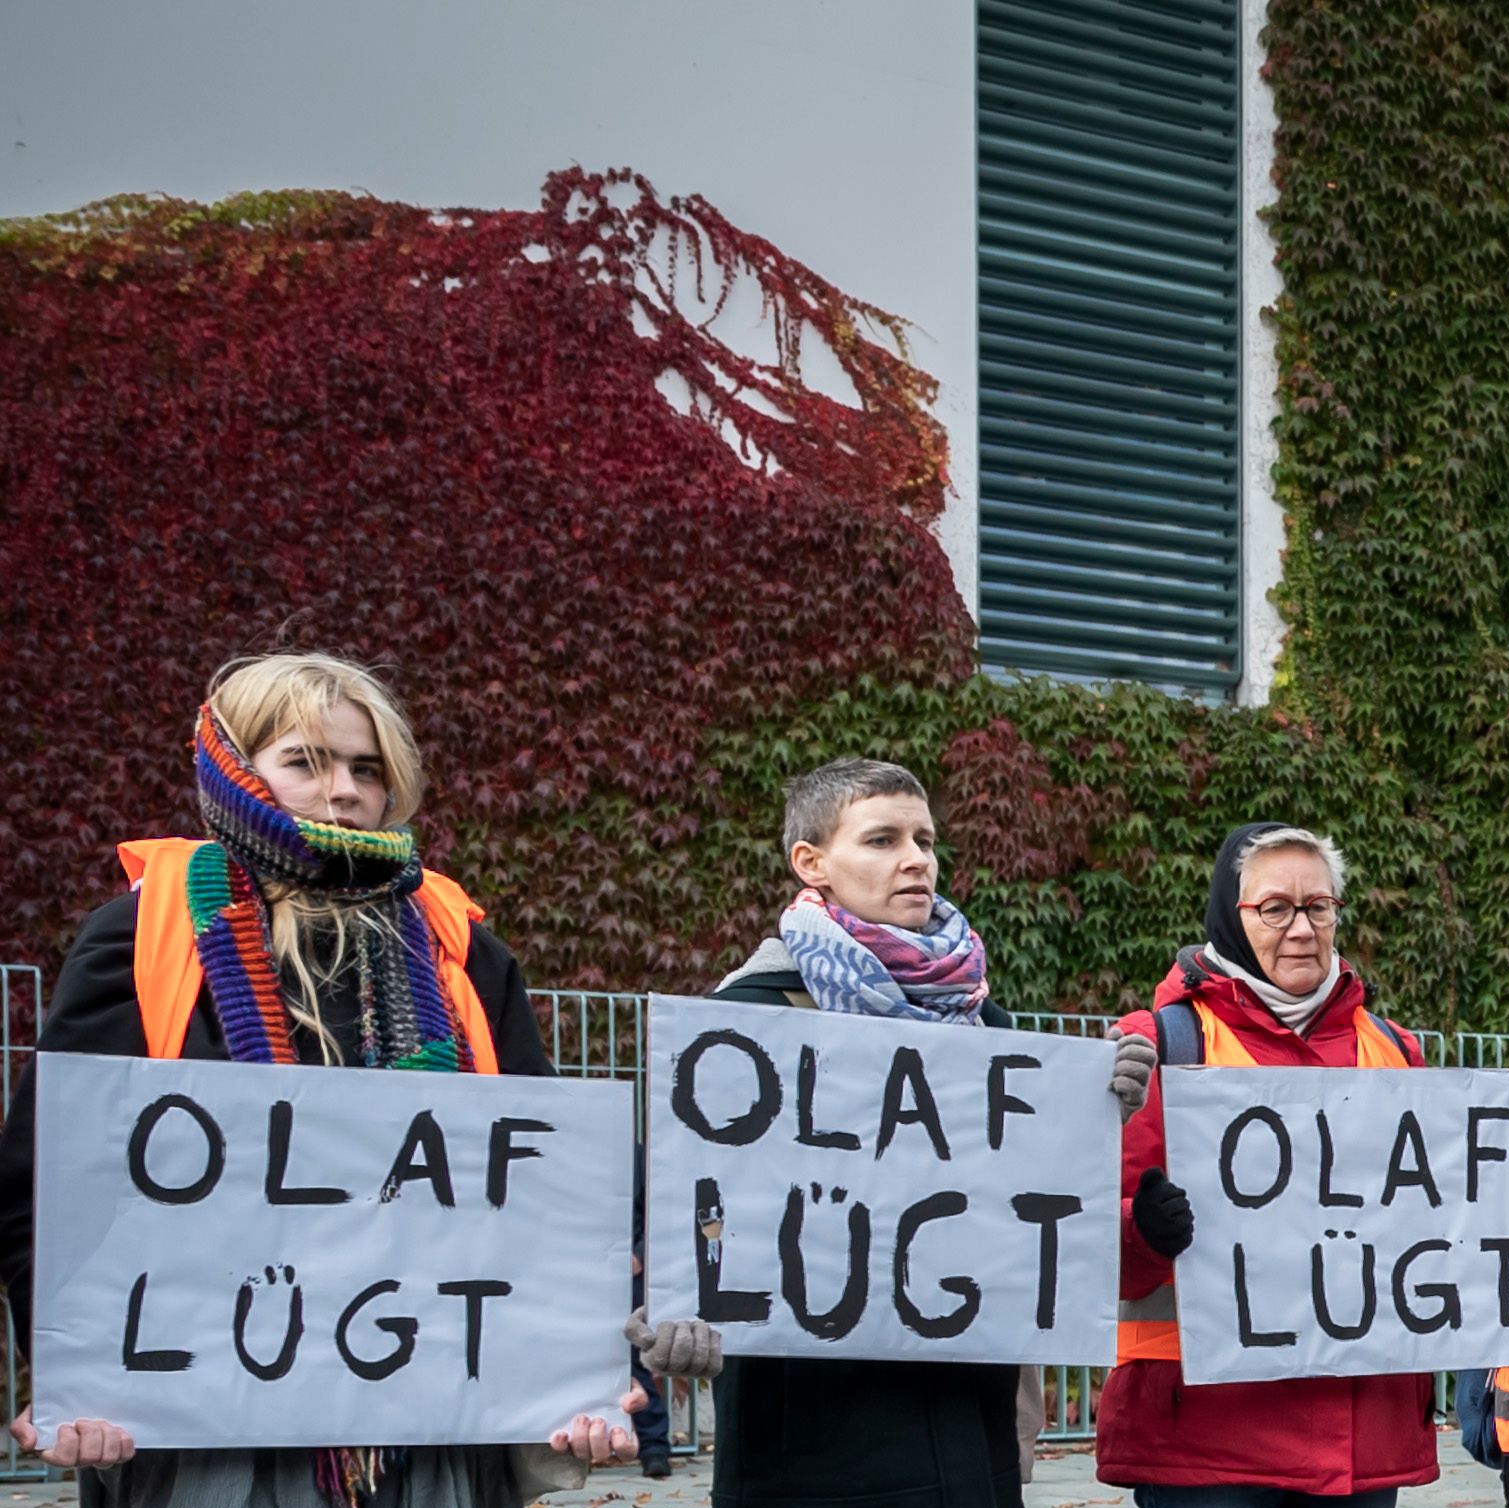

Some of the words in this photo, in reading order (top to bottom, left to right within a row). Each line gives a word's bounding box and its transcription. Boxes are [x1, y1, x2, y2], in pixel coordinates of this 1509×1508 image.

[127, 1092, 556, 1209] OLAF
[670, 1028, 1042, 1161] OLAF
[122, 1262, 513, 1382] LÜGT
[694, 1177, 1083, 1342] LÜGT
